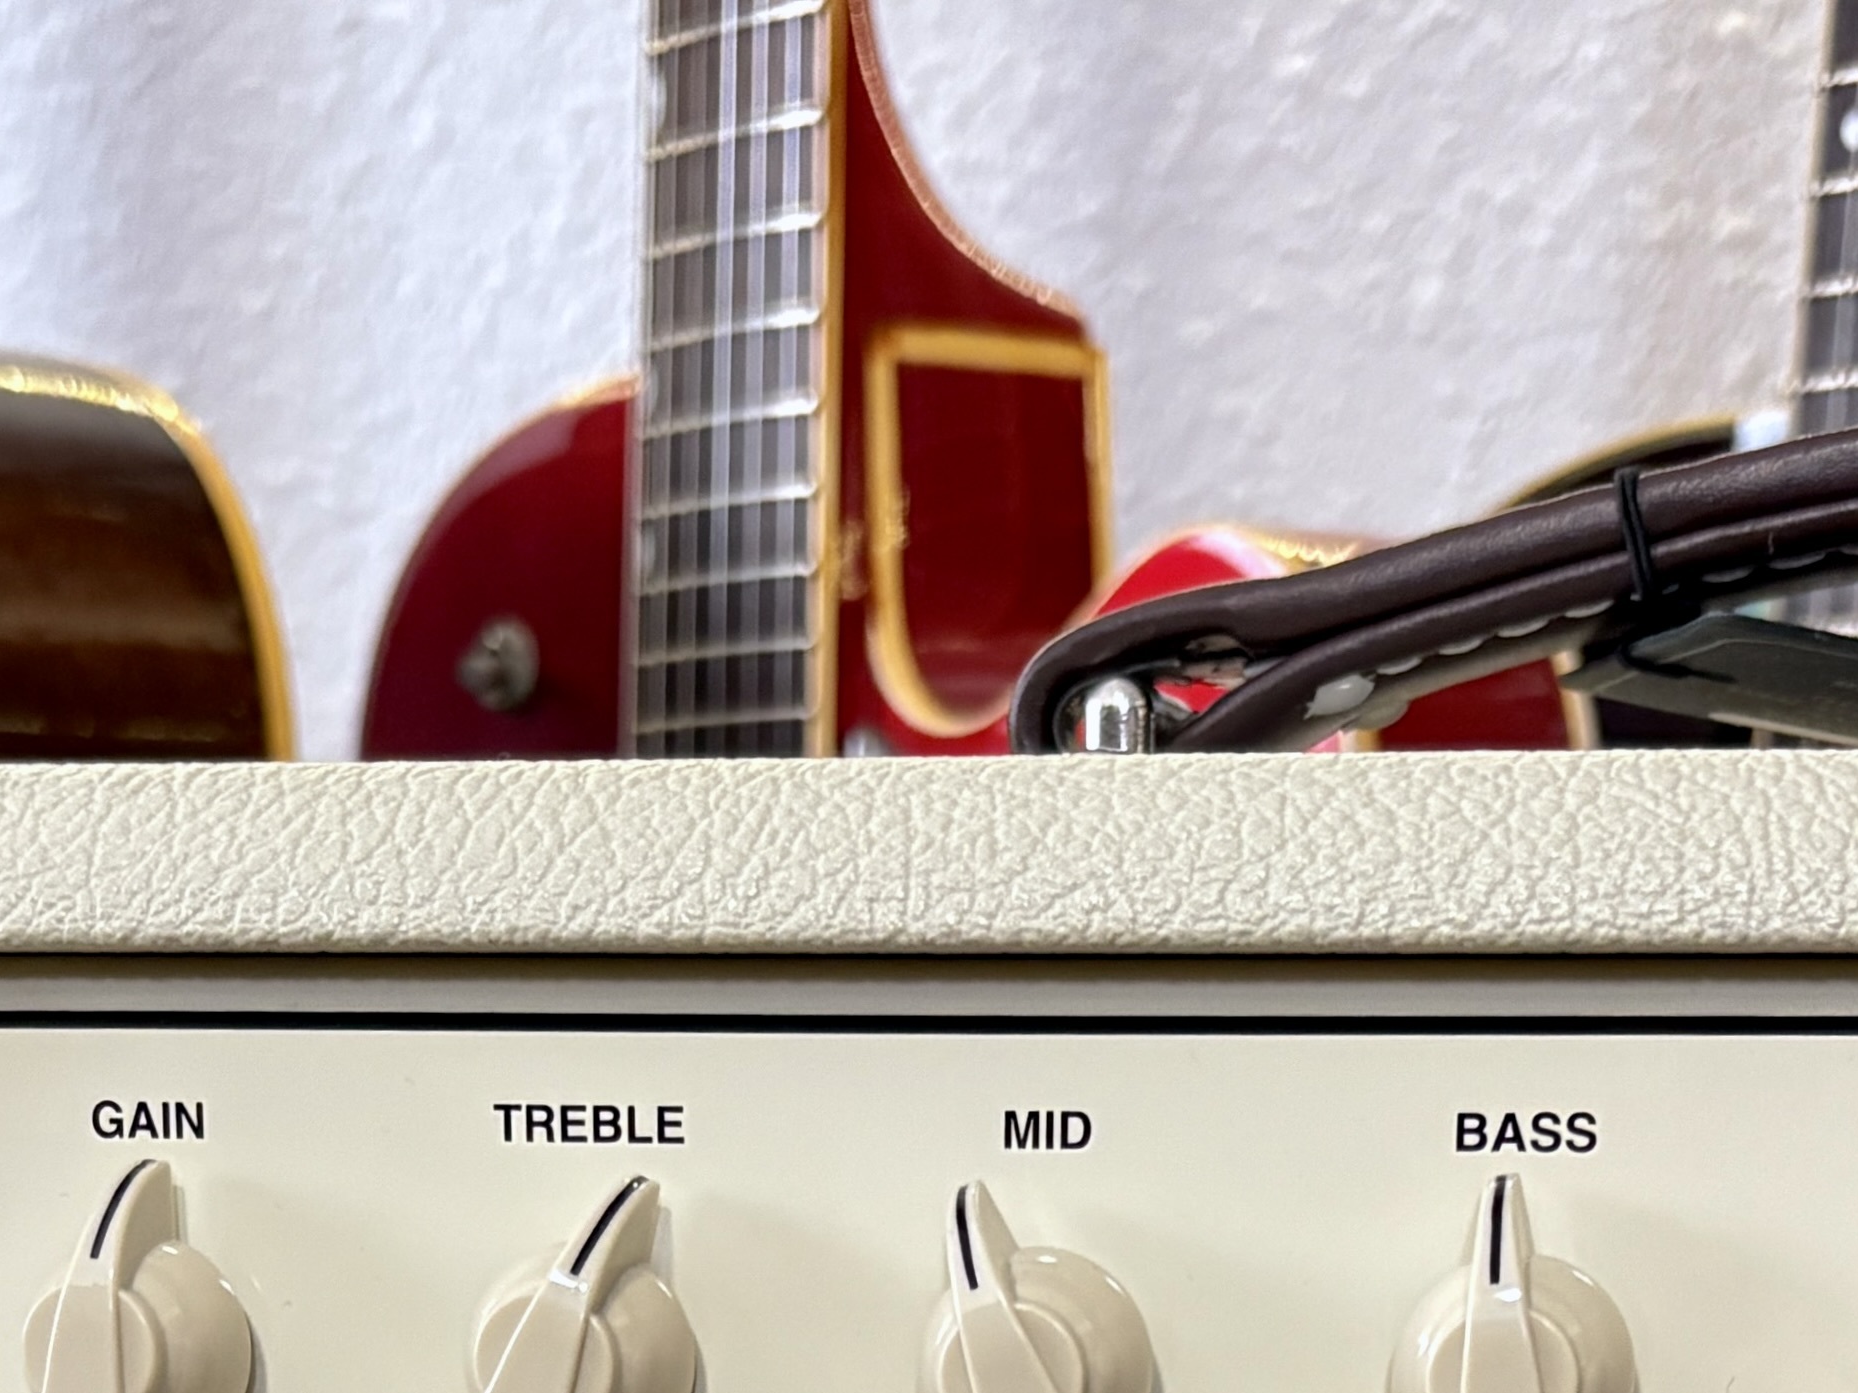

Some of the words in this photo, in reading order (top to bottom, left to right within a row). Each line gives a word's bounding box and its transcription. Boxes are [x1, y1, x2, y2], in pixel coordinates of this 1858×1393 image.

[91, 1099, 205, 1140] GAIN
[492, 1103, 685, 1145] TREBLE
[1003, 1110, 1092, 1150] MID
[1455, 1111, 1597, 1153] BASS
